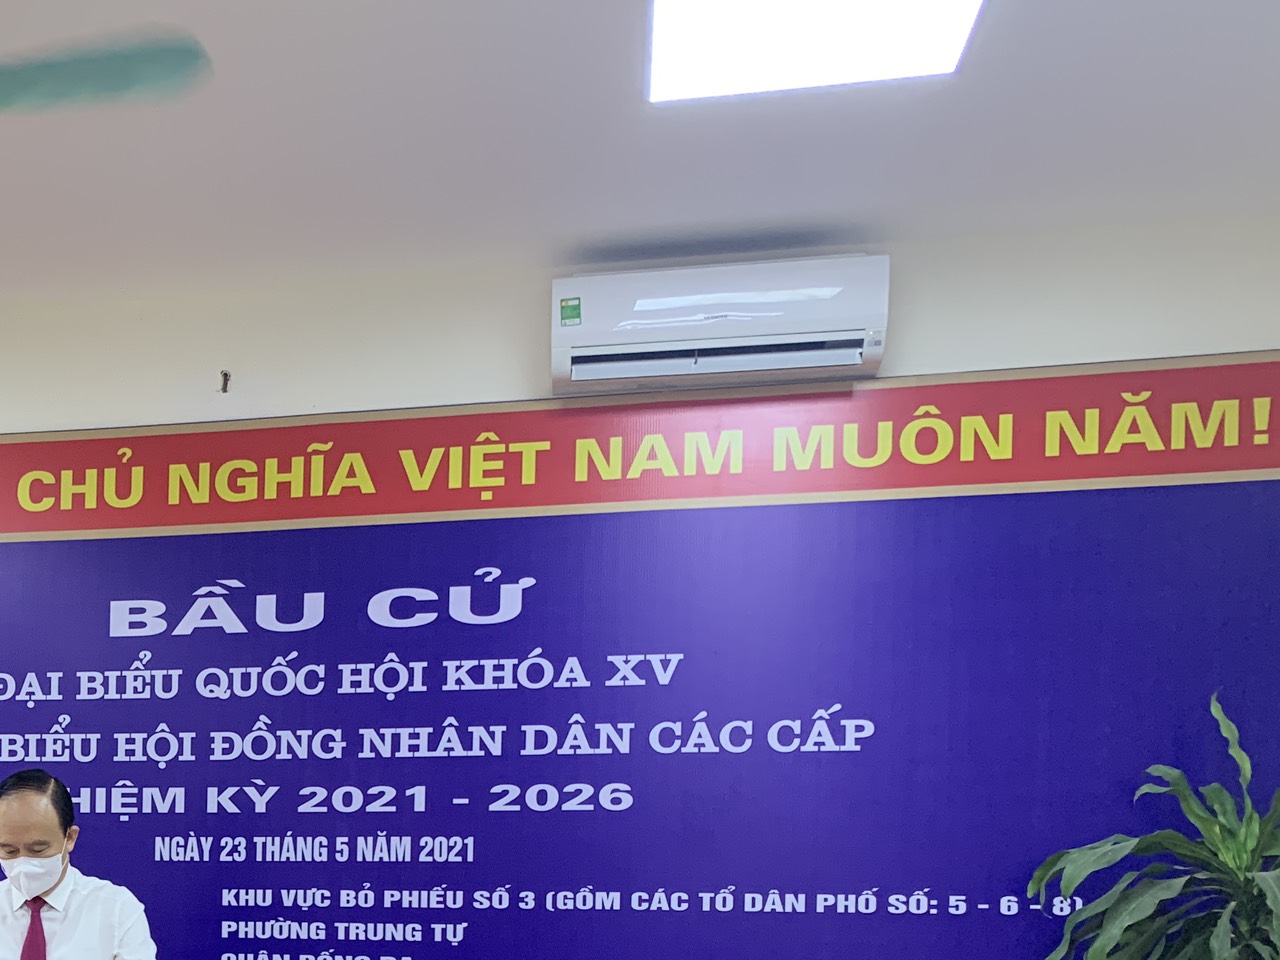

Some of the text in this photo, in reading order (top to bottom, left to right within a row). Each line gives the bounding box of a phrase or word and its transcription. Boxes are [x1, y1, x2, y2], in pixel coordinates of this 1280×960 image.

[16, 447, 145, 511] CHỦ
[168, 442, 376, 506] NGHĨA
[399, 431, 551, 502] VIỆT
[574, 431, 744, 482] NAM
[772, 405, 1014, 473] MUÔN
[1043, 391, 1272, 457] NĂM!
[109, 567, 537, 637] BẦU CỬ
[76, 650, 183, 699] BIỂU
[195, 650, 325, 700] QUỐC
[337, 652, 428, 701] HỘI
[442, 647, 590, 692] KHÓA
[605, 653, 684, 687] XV
[113, 722, 196, 769] HỘI
[210, 714, 347, 761] ĐỒNG
[358, 716, 507, 759] NHÂN
[520, 713, 635, 757] DÂN
[648, 710, 753, 754] CÁC
[766, 703, 876, 753] CẤP
[67, 779, 634, 822] HIỆM KỲ 2021 - 2026
[154, 830, 475, 863] NGÀY 23 THÁNG 5 NĂM 2021
[221, 888, 272, 908] KHU
[281, 887, 331, 911] VỰC
[339, 882, 376, 909] BỎ
[383, 884, 464, 910] PHIẾU
[472, 884, 511, 910] SỐ
[518, 890, 536, 910] 3
[545, 885, 621, 912] (GỒM
[630, 886, 690, 912] CÁC
[699, 885, 736, 912] TỔ
[744, 889, 807, 914] DÂN
[816, 886, 880, 914] PHỐ
[887, 888, 938, 915] SỐ:
[948, 894, 967, 916] 5
[999, 895, 1019, 916] 6
[221, 916, 467, 946] PHƯỜNG TRUNG TỰ
